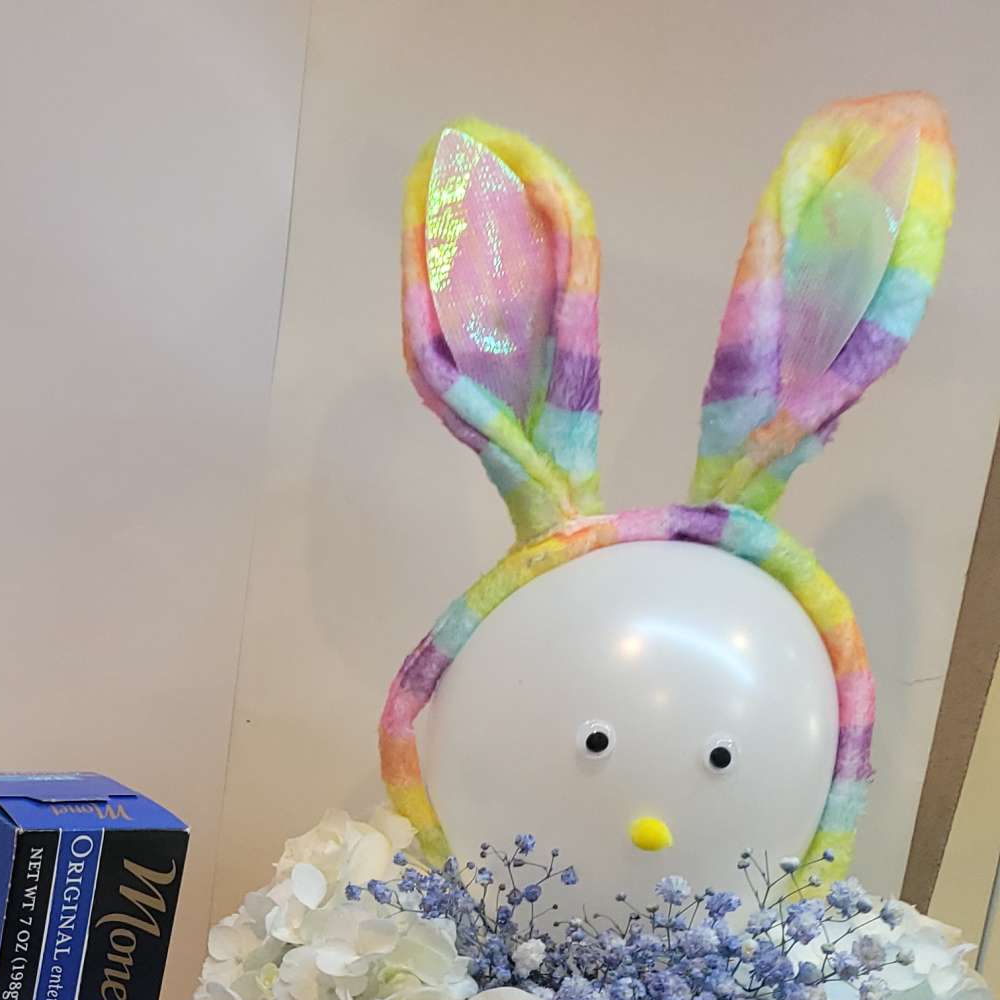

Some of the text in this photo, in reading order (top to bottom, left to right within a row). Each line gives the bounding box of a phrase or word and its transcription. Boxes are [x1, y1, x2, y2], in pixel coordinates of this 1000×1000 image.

[27, 847, 44, 882] NET
[21, 885, 37, 911] WT
[53, 834, 94, 961] ORIGINAL
[17, 916, 32, 926] 7
[14, 931, 31, 952] OZ
